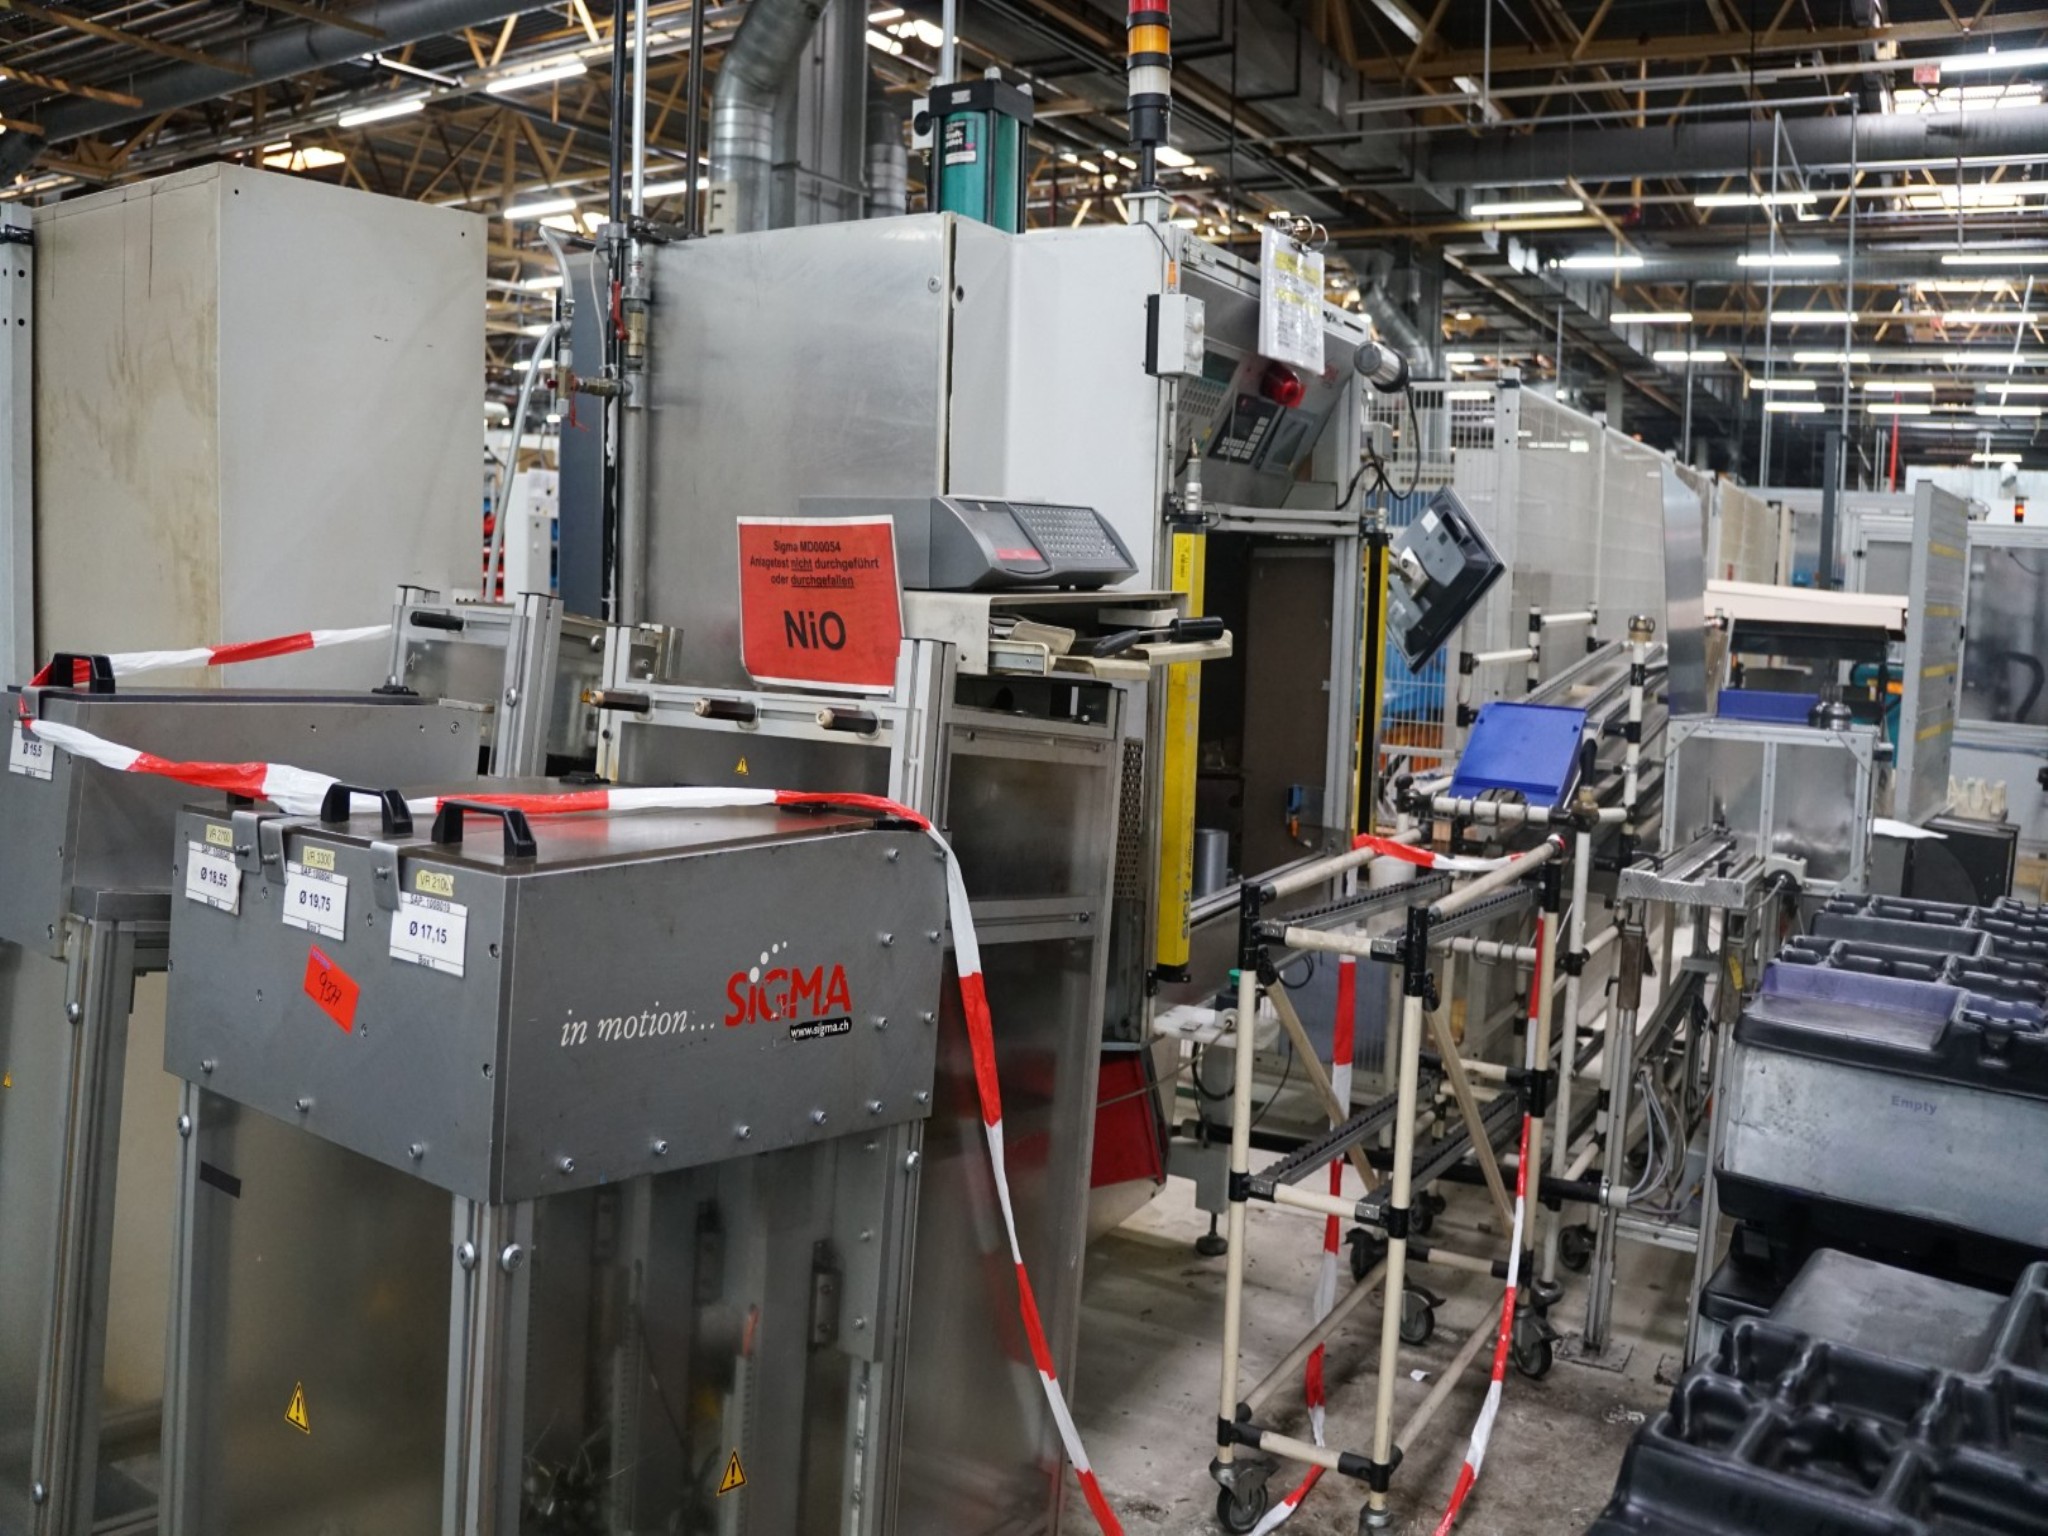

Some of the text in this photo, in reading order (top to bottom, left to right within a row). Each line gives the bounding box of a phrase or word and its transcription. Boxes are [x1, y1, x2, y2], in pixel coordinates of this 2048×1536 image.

[773, 540, 799, 554] Sigma
[791, 557, 812, 571] nicht
[815, 557, 880, 571] durchgeführt
[771, 574, 854, 588] oder durchgefallen
[783, 610, 846, 650] NiO
[420, 873, 431, 887] VR
[309, 893, 331, 912] 19,75
[421, 923, 448, 945] 17,15
[561, 1008, 588, 1047] in
[790, 1019, 850, 1038] www.sigma.ch
[1891, 1095, 1938, 1116] Empty
